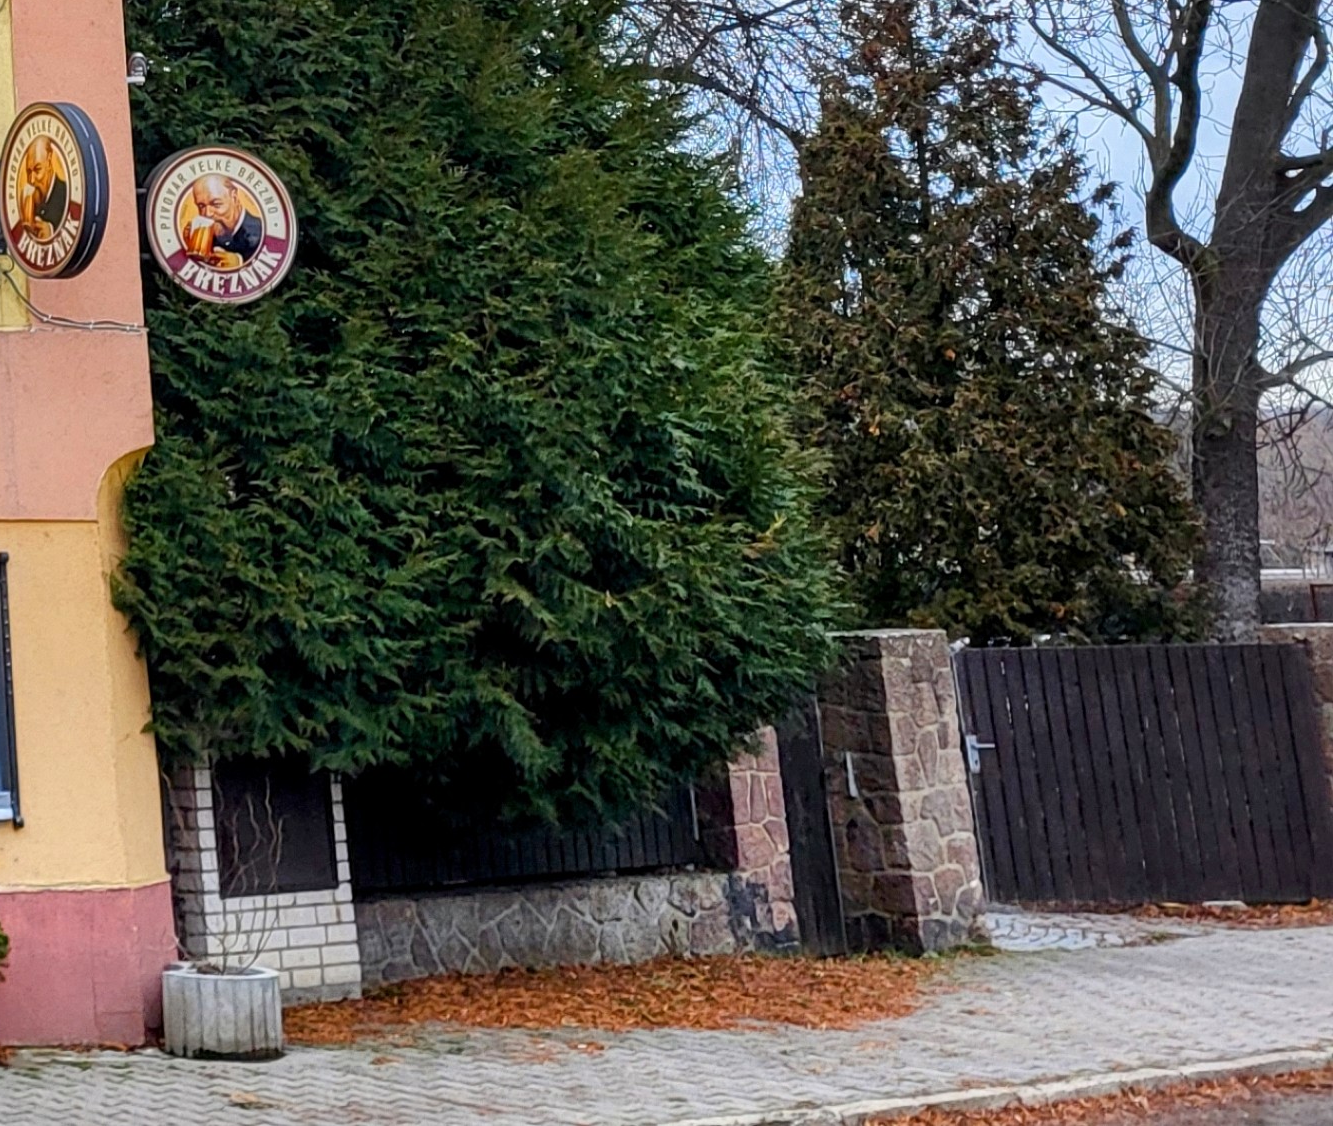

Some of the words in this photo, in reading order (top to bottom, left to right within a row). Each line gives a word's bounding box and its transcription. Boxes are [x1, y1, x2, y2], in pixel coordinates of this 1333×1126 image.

[26, 118, 52, 138] VELKÉ
[160, 173, 188, 231] PIVOVAR
[188, 159, 232, 174] VELKÉ
[237, 166, 279, 215] BŘEZNO
